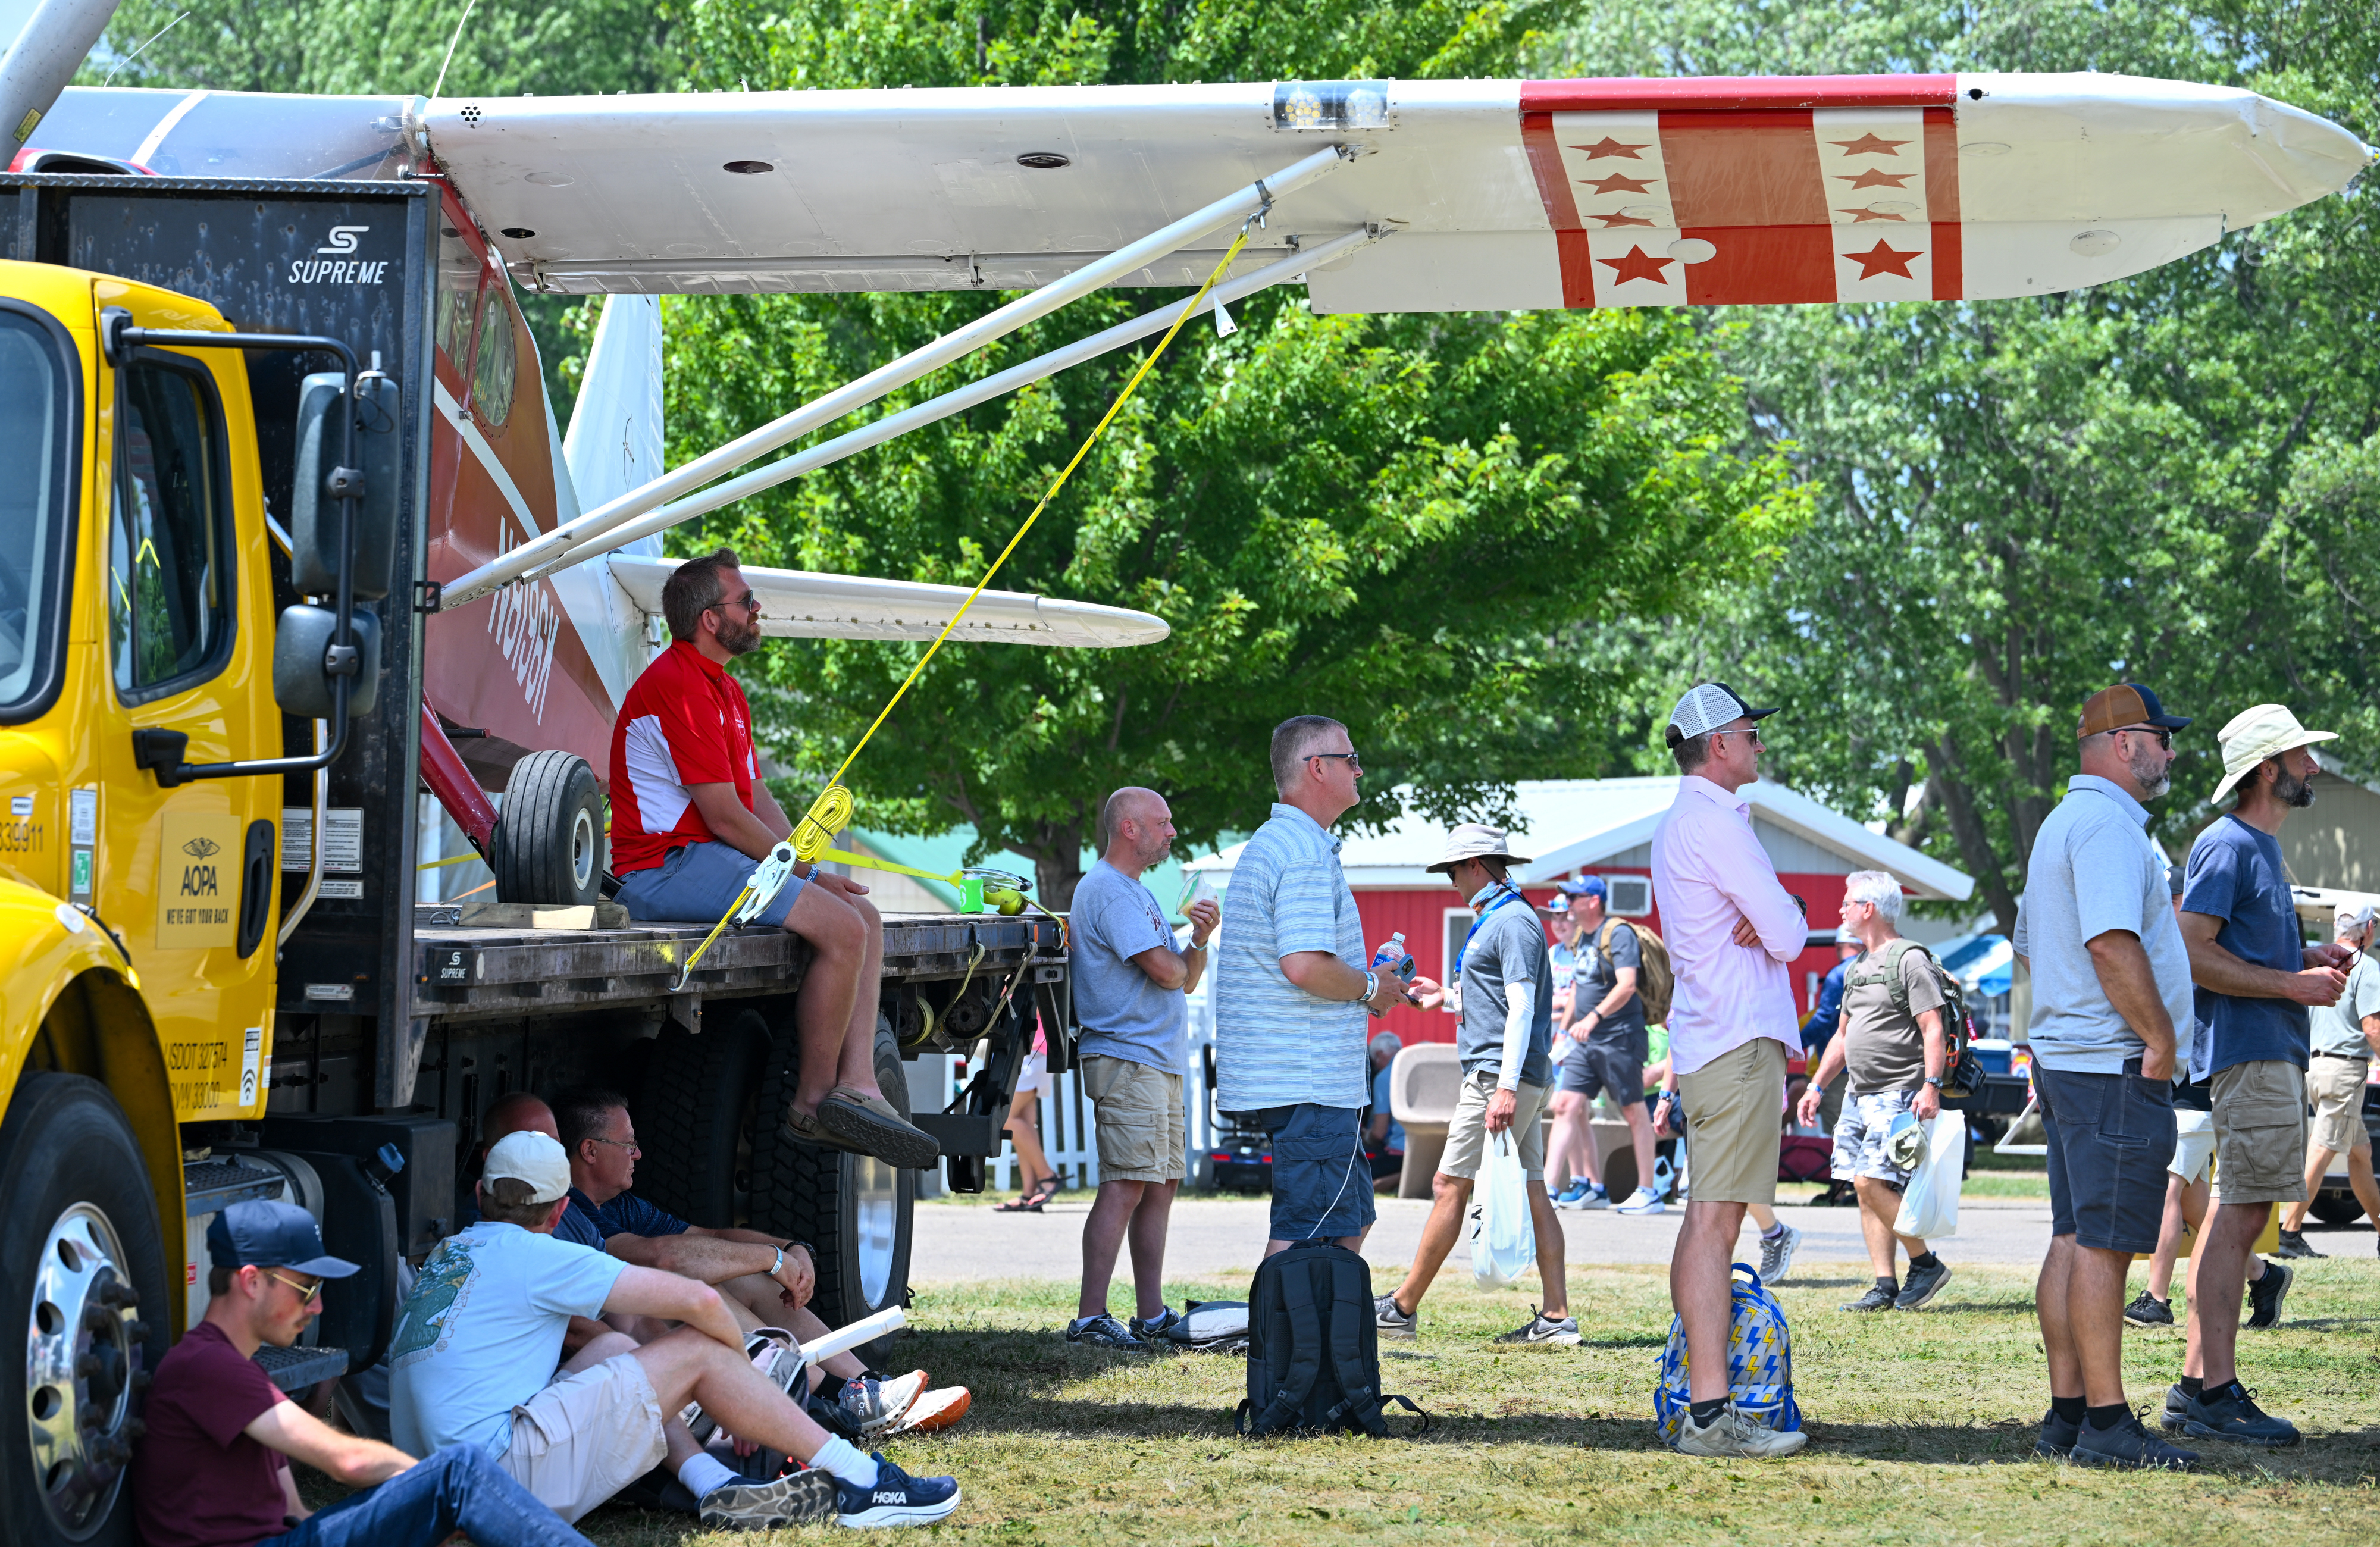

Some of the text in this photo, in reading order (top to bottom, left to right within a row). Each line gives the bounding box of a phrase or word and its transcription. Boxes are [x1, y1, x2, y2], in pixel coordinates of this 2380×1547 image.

[289, 260, 389, 284] SUPREME
[180, 865, 218, 897] AOPA
[167, 908, 229, 924] WE'VE GOT YOUR BACK
[440, 967, 466, 979] SUPREME
[197, 1041, 228, 1070] 327574
[872, 1491, 907, 1504] HOKA
